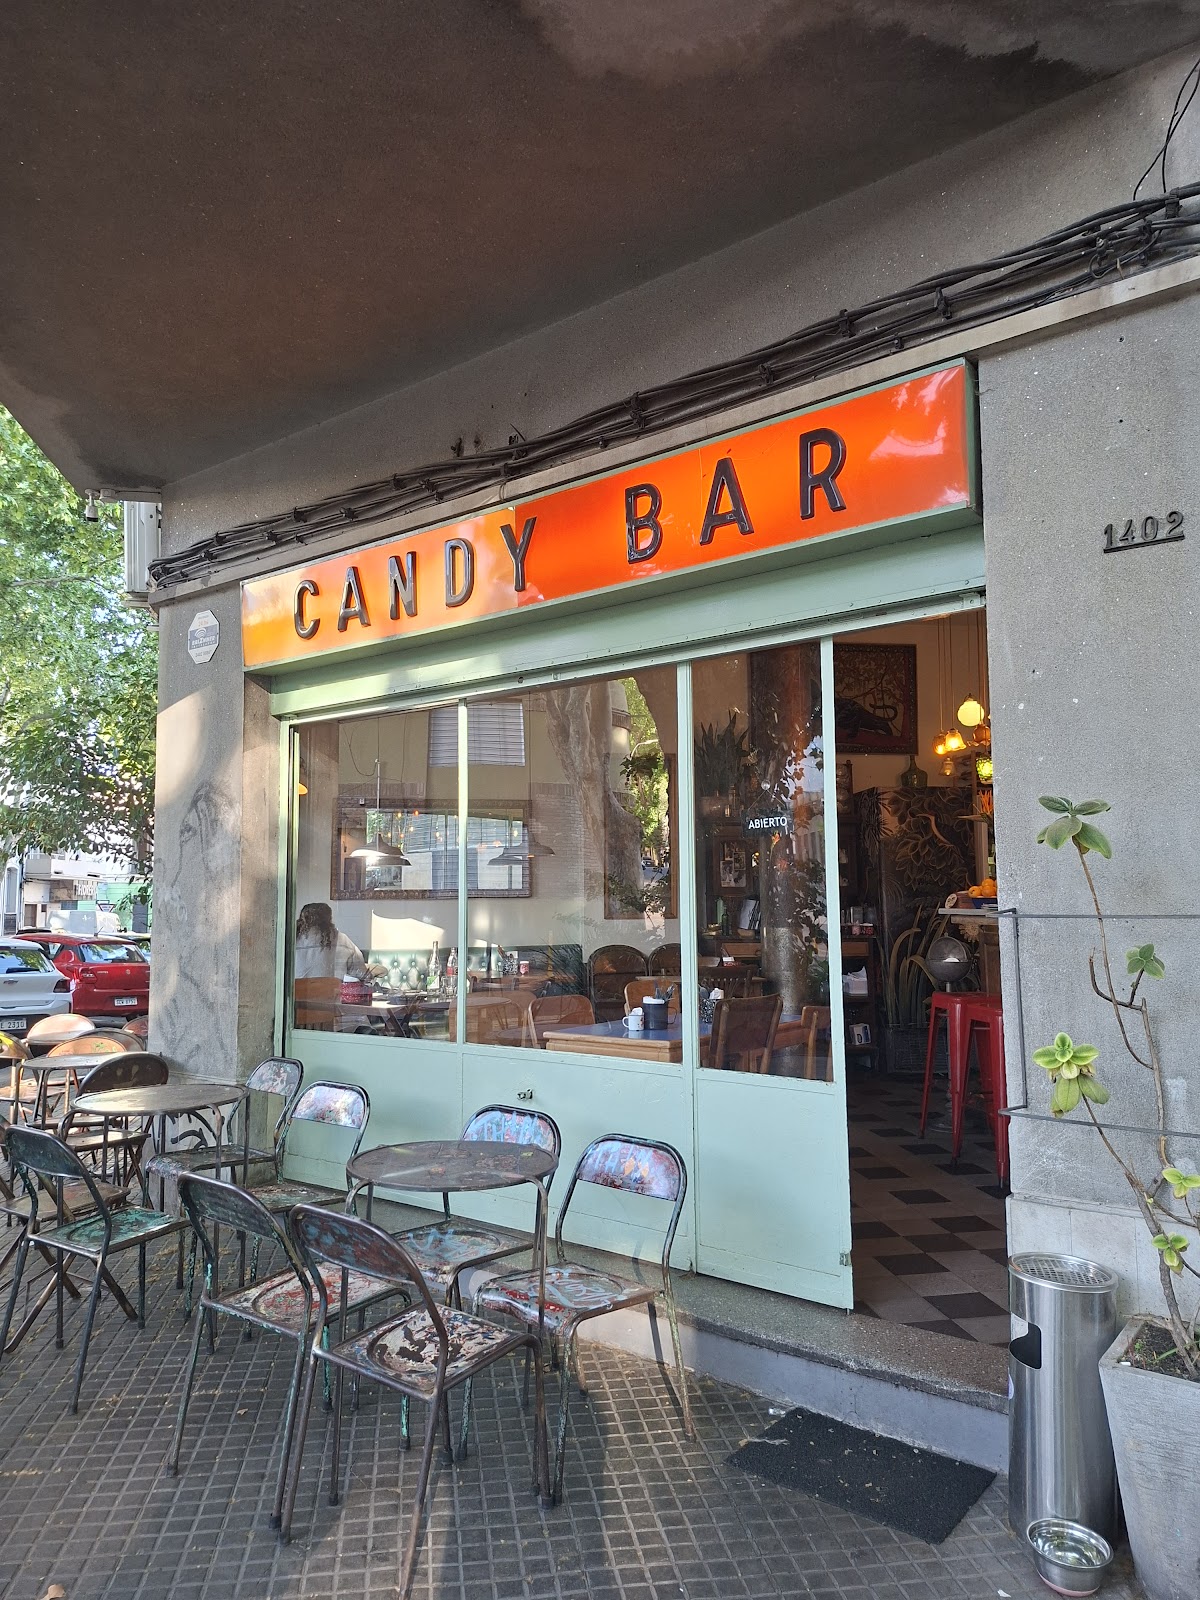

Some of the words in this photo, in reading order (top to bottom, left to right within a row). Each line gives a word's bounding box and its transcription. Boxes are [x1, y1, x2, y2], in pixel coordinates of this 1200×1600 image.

[293, 517, 537, 640] CANDY
[624, 428, 847, 564] BAR
[1103, 511, 1185, 549] 1402
[748, 816, 788, 830] ABIERTO
